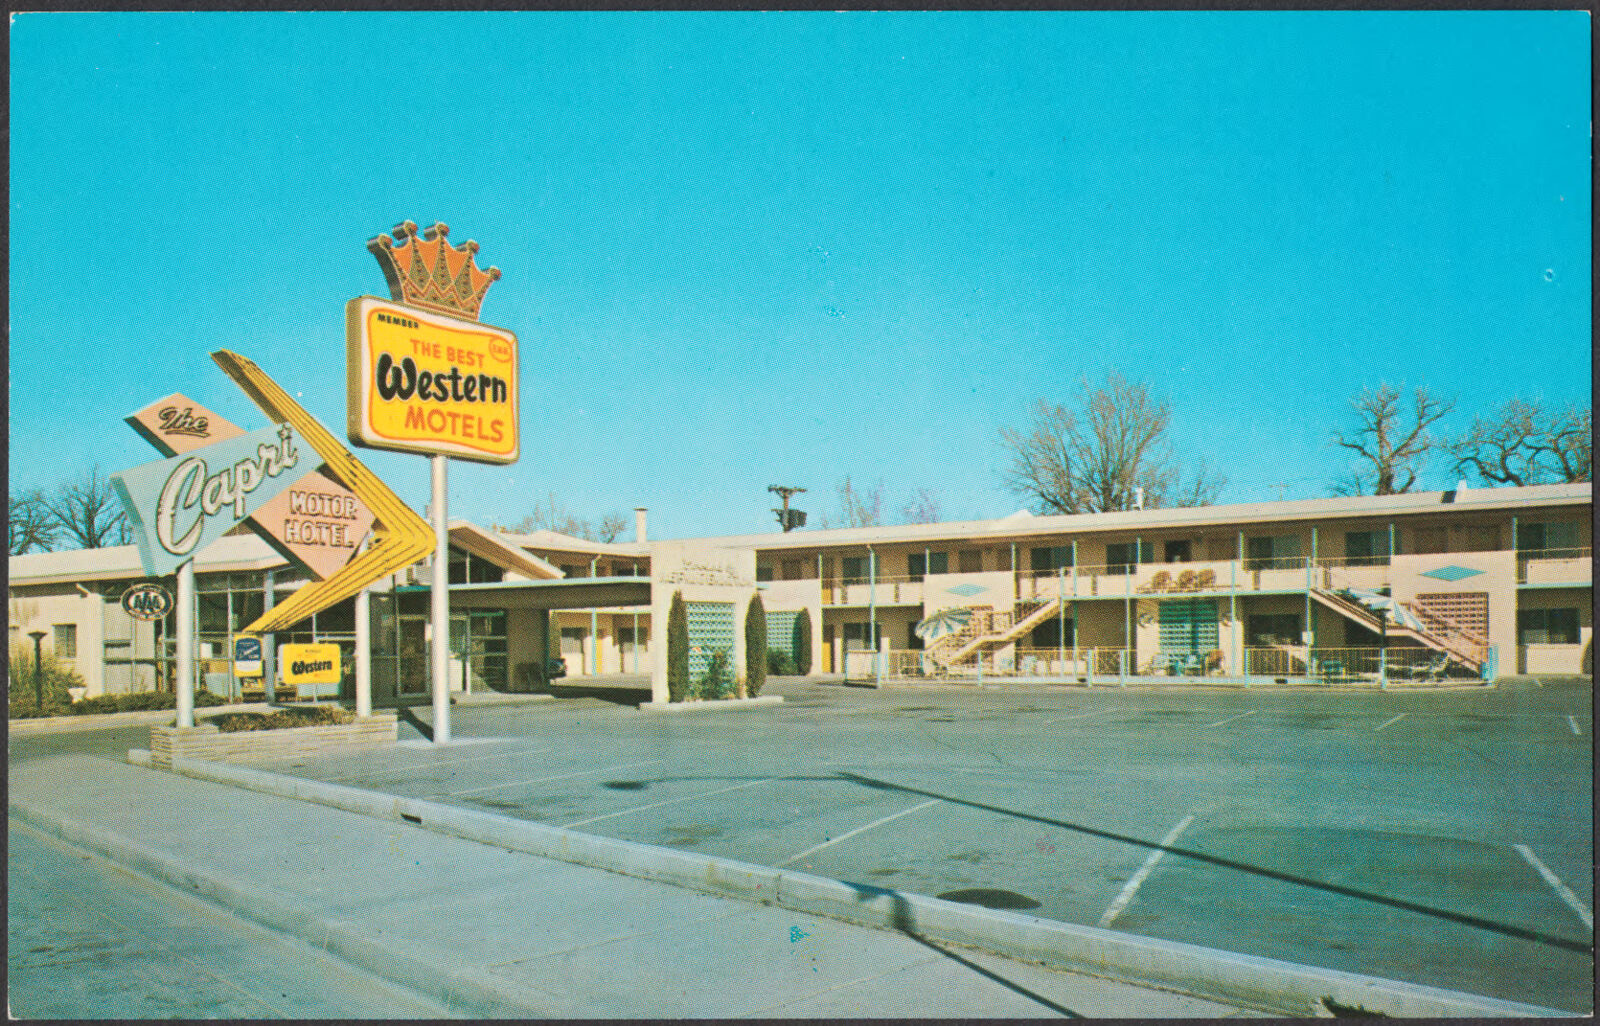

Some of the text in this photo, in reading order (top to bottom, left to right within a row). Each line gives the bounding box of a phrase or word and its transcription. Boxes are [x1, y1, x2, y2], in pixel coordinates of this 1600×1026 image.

[377, 314, 418, 328] MEMBER
[411, 339, 441, 358] THE
[447, 346, 485, 368] BEST
[377, 353, 507, 403] Western
[158, 406, 210, 437] The
[405, 406, 504, 442] MOTELS
[156, 423, 298, 556] Capri
[289, 490, 359, 521] MOTOR
[284, 518, 355, 549] HOTEL
[133, 591, 161, 612] AAA
[292, 660, 333, 676] Western
